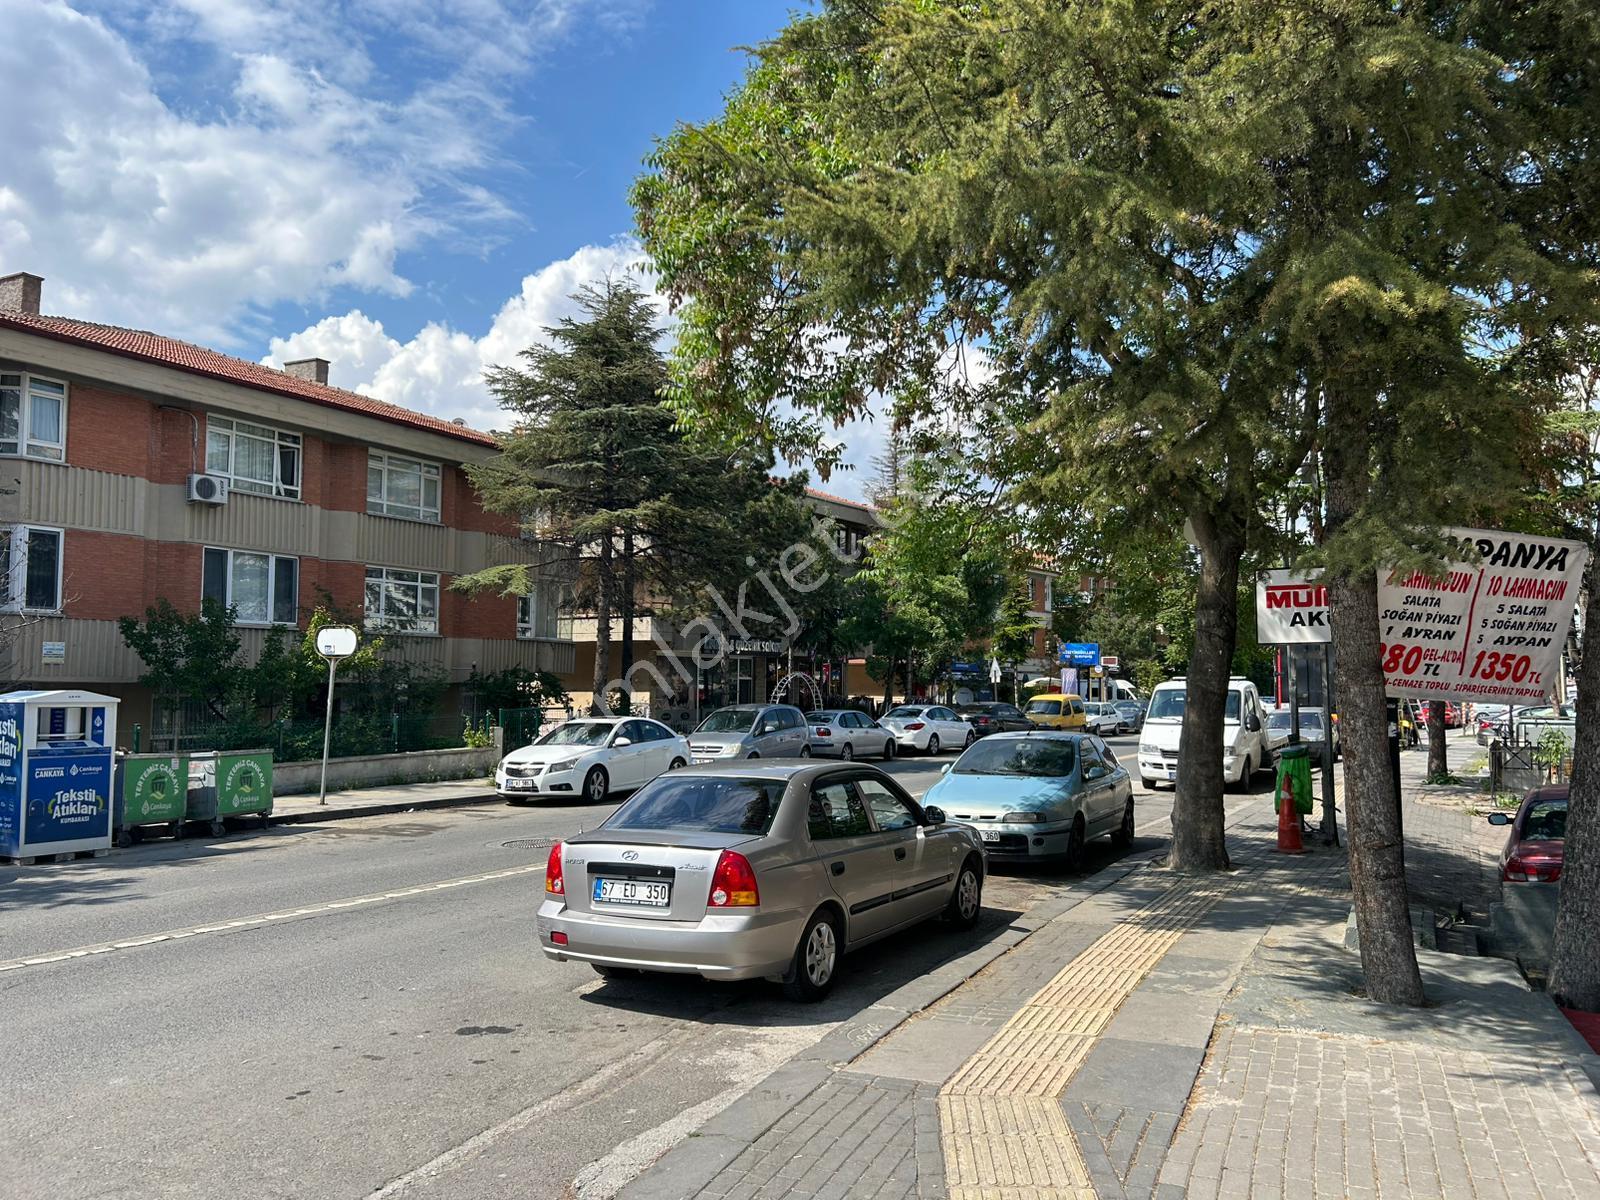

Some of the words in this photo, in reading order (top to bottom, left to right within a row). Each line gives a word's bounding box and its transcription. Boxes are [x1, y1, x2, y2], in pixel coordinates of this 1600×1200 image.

[1486, 576, 1503, 596] 10
[1503, 576, 1568, 600] LAHMACUN
[1402, 595, 1441, 607] SALATA
[1381, 608, 1423, 623] SOĞAN
[1425, 610, 1462, 625] PİYAZI
[1496, 604, 1506, 614] 5
[1508, 604, 1547, 616] SALATA
[1481, 618, 1489, 628] 5
[1490, 617, 1525, 630] SOĞAN
[1525, 619, 1557, 632] PİYAZI
[1386, 625, 1394, 636] 1
[1402, 626, 1456, 640] AYRAN
[1476, 634, 1484, 644] 5
[1423, 663, 1440, 676] TL
[1469, 650, 1531, 683] 1350
[1528, 671, 1542, 684] TL
[1425, 680, 1451, 691] TOPLU
[1515, 687, 1545, 698] YAPILIR
[34, 769, 64, 779] ÇANKAYA
[55, 788, 96, 804] Tekstil
[52, 801, 97, 819] Atıkları
[985, 831, 999, 840] 360
[602, 882, 614, 896] 67
[624, 884, 636, 898] ED
[646, 885, 667, 900] 350
